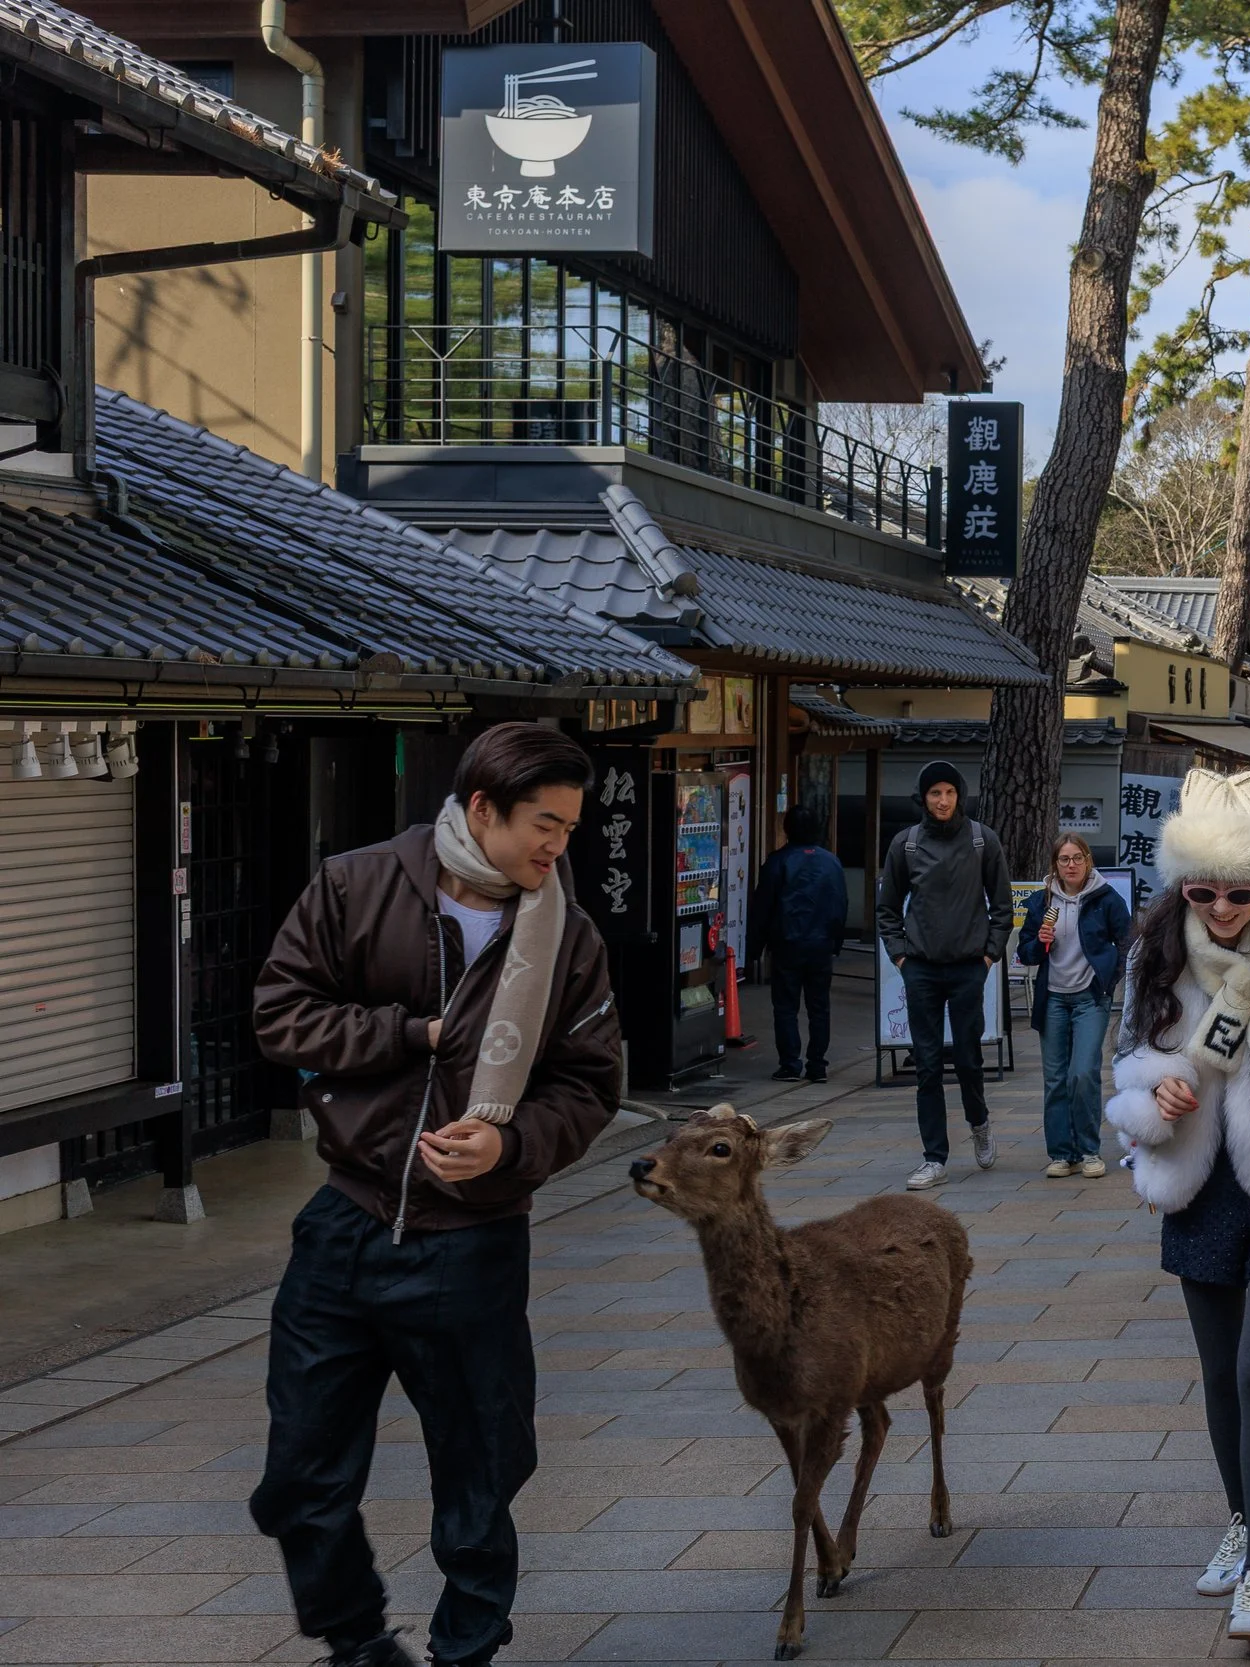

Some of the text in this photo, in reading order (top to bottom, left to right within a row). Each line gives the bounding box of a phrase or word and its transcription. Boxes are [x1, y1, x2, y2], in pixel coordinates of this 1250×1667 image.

[463, 184, 616, 211] 東京庵本店
[488, 228, 591, 236] TOKYOAN-HONTEN
[599, 765, 636, 913] 松雲堂
